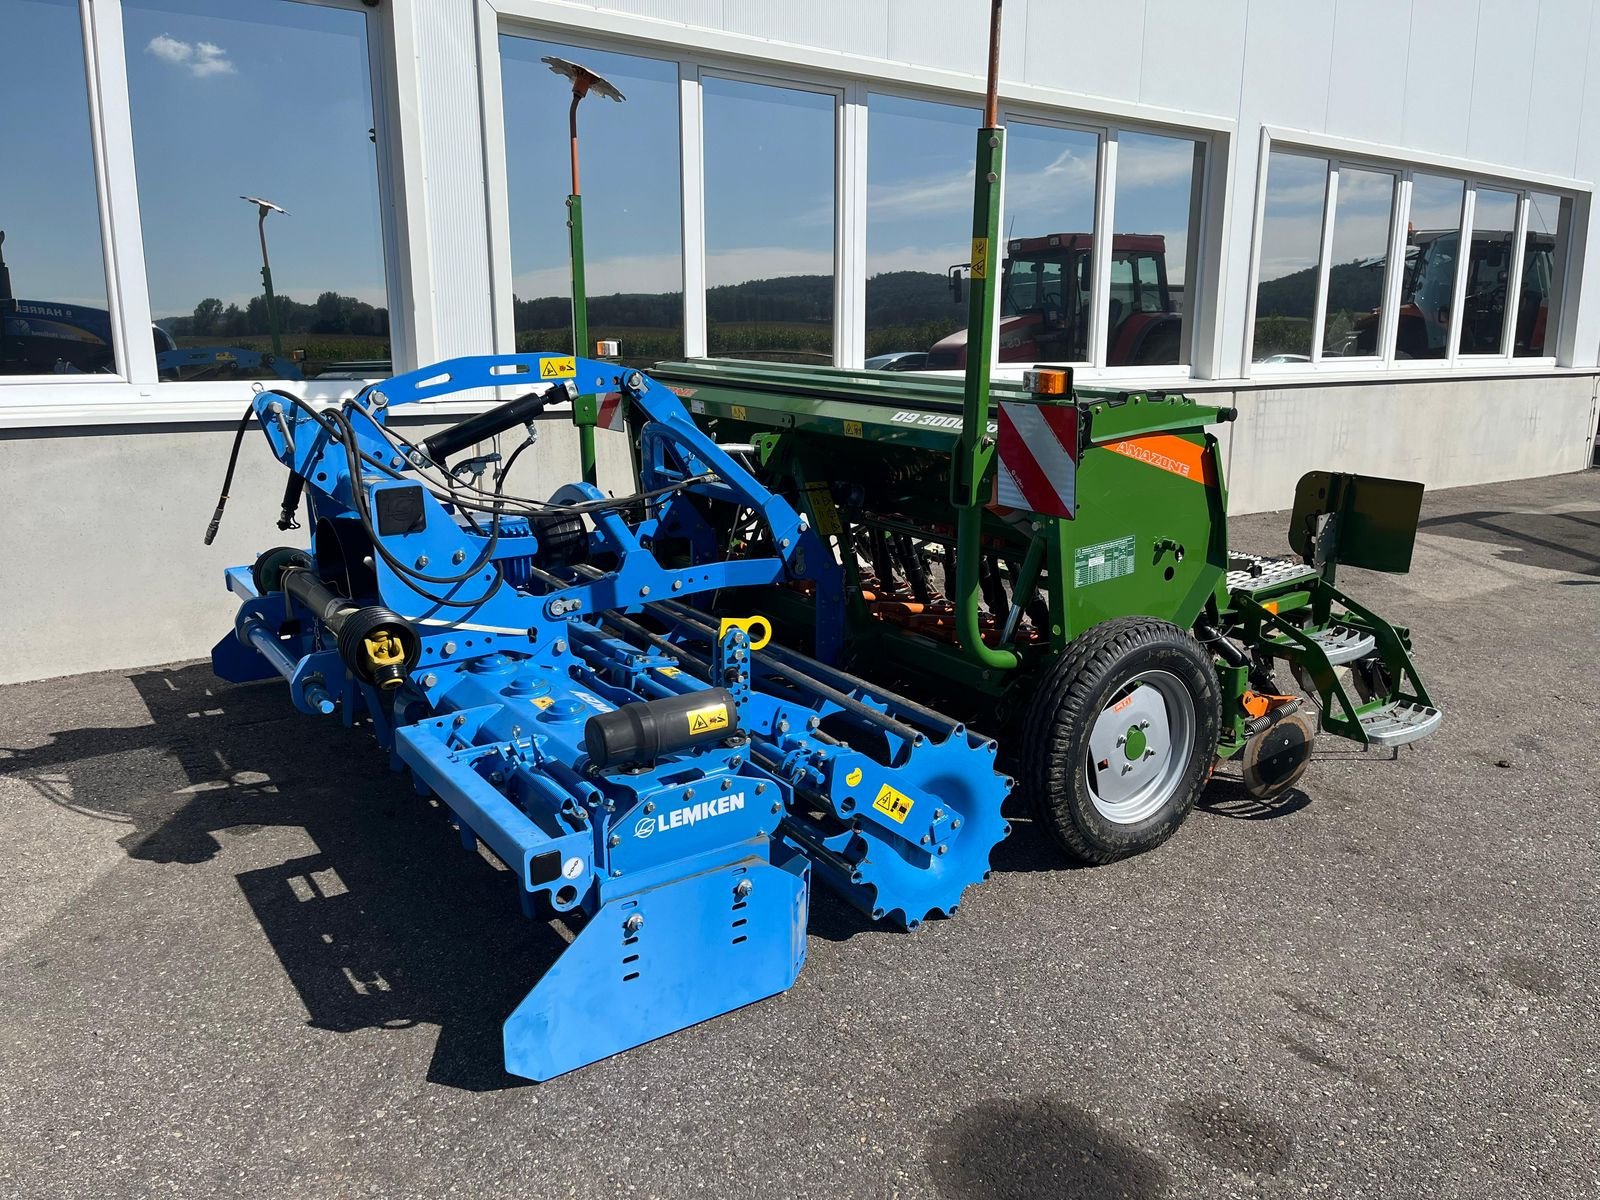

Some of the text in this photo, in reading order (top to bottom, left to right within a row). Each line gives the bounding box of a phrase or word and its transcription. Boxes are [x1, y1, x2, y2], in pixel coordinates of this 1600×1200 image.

[890, 411, 920, 423] D9
[1116, 441, 1190, 477] AMAZONE
[657, 792, 745, 832] LEMKEN
